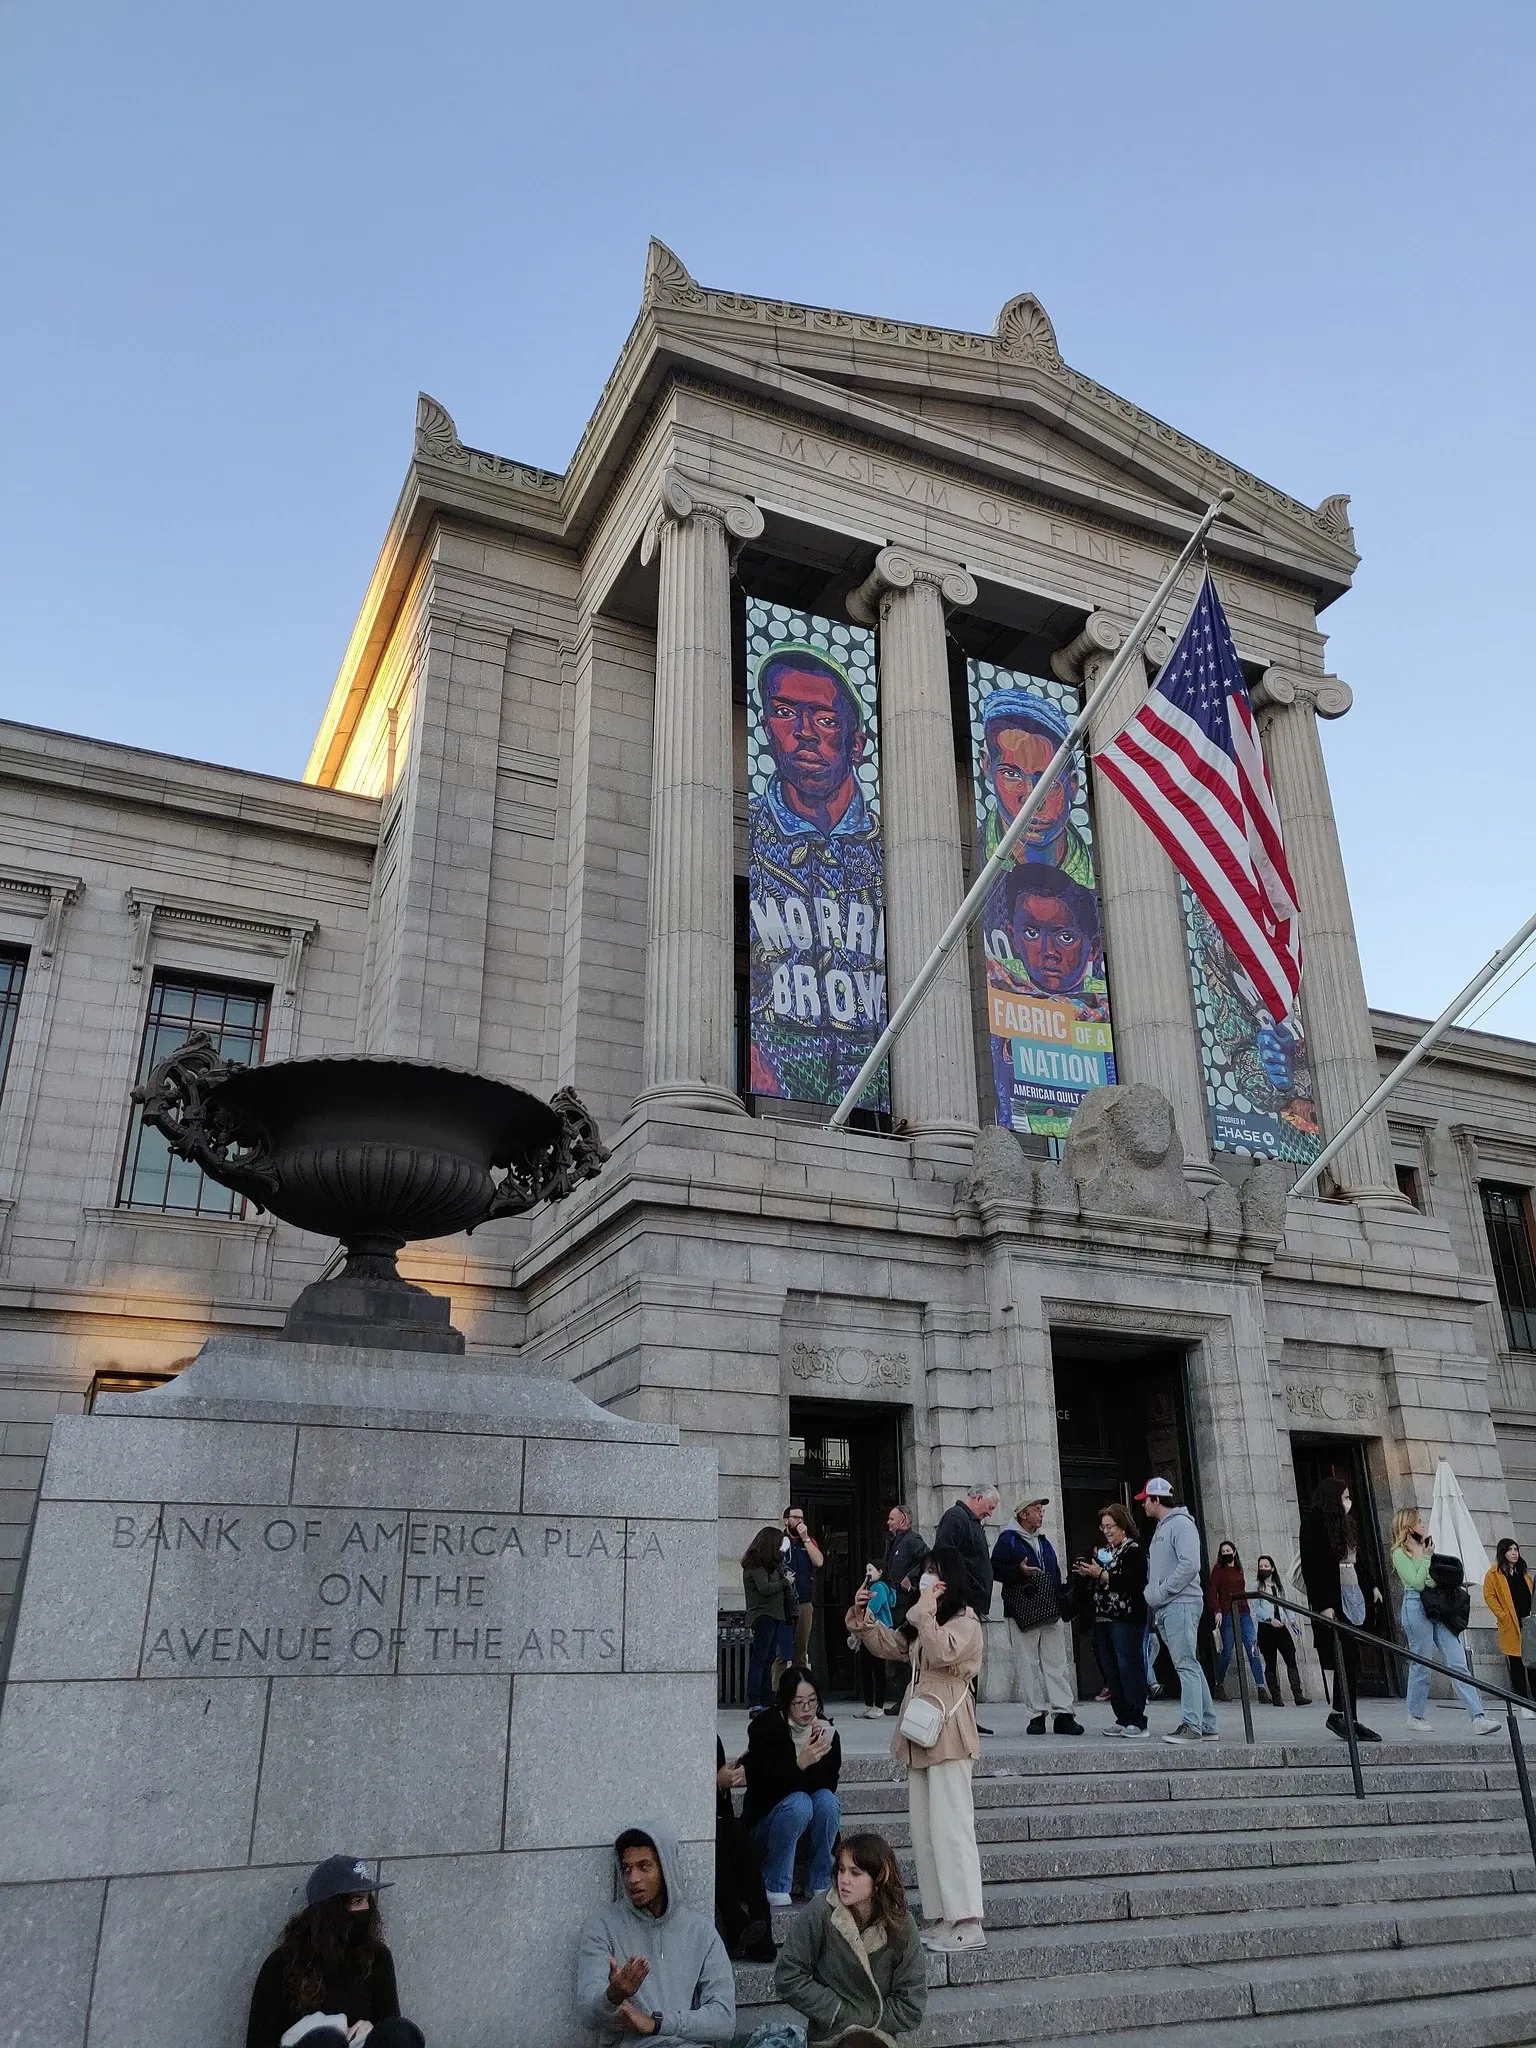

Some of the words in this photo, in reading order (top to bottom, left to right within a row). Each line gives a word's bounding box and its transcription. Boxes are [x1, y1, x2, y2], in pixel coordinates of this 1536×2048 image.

[779, 431, 950, 510] MVSEVM
[977, 500, 1022, 532] OF
[1049, 522, 1135, 571] FINE
[1158, 560, 1242, 606] ARTS
[772, 963, 886, 1024] BROW
[993, 997, 1067, 1040] FABRIC
[1075, 1026, 1092, 1046] OF
[1096, 1028, 1107, 1047] A
[1019, 1046, 1100, 1085] NATION
[1013, 1083, 1055, 1102] AMERICAN
[1056, 1090, 1080, 1105] QUILT
[1217, 1125, 1262, 1143] CHASE
[111, 1515, 242, 1551] BANK
[262, 1518, 323, 1552] OF
[339, 1521, 525, 1557] AMERICA
[542, 1527, 666, 1561] PLAZA
[318, 1572, 388, 1607] ON
[406, 1574, 486, 1607] THE
[146, 1627, 333, 1663] AVENUE
[350, 1626, 409, 1664] OF
[424, 1627, 504, 1661] THE
[517, 1627, 617, 1661] ARTS
